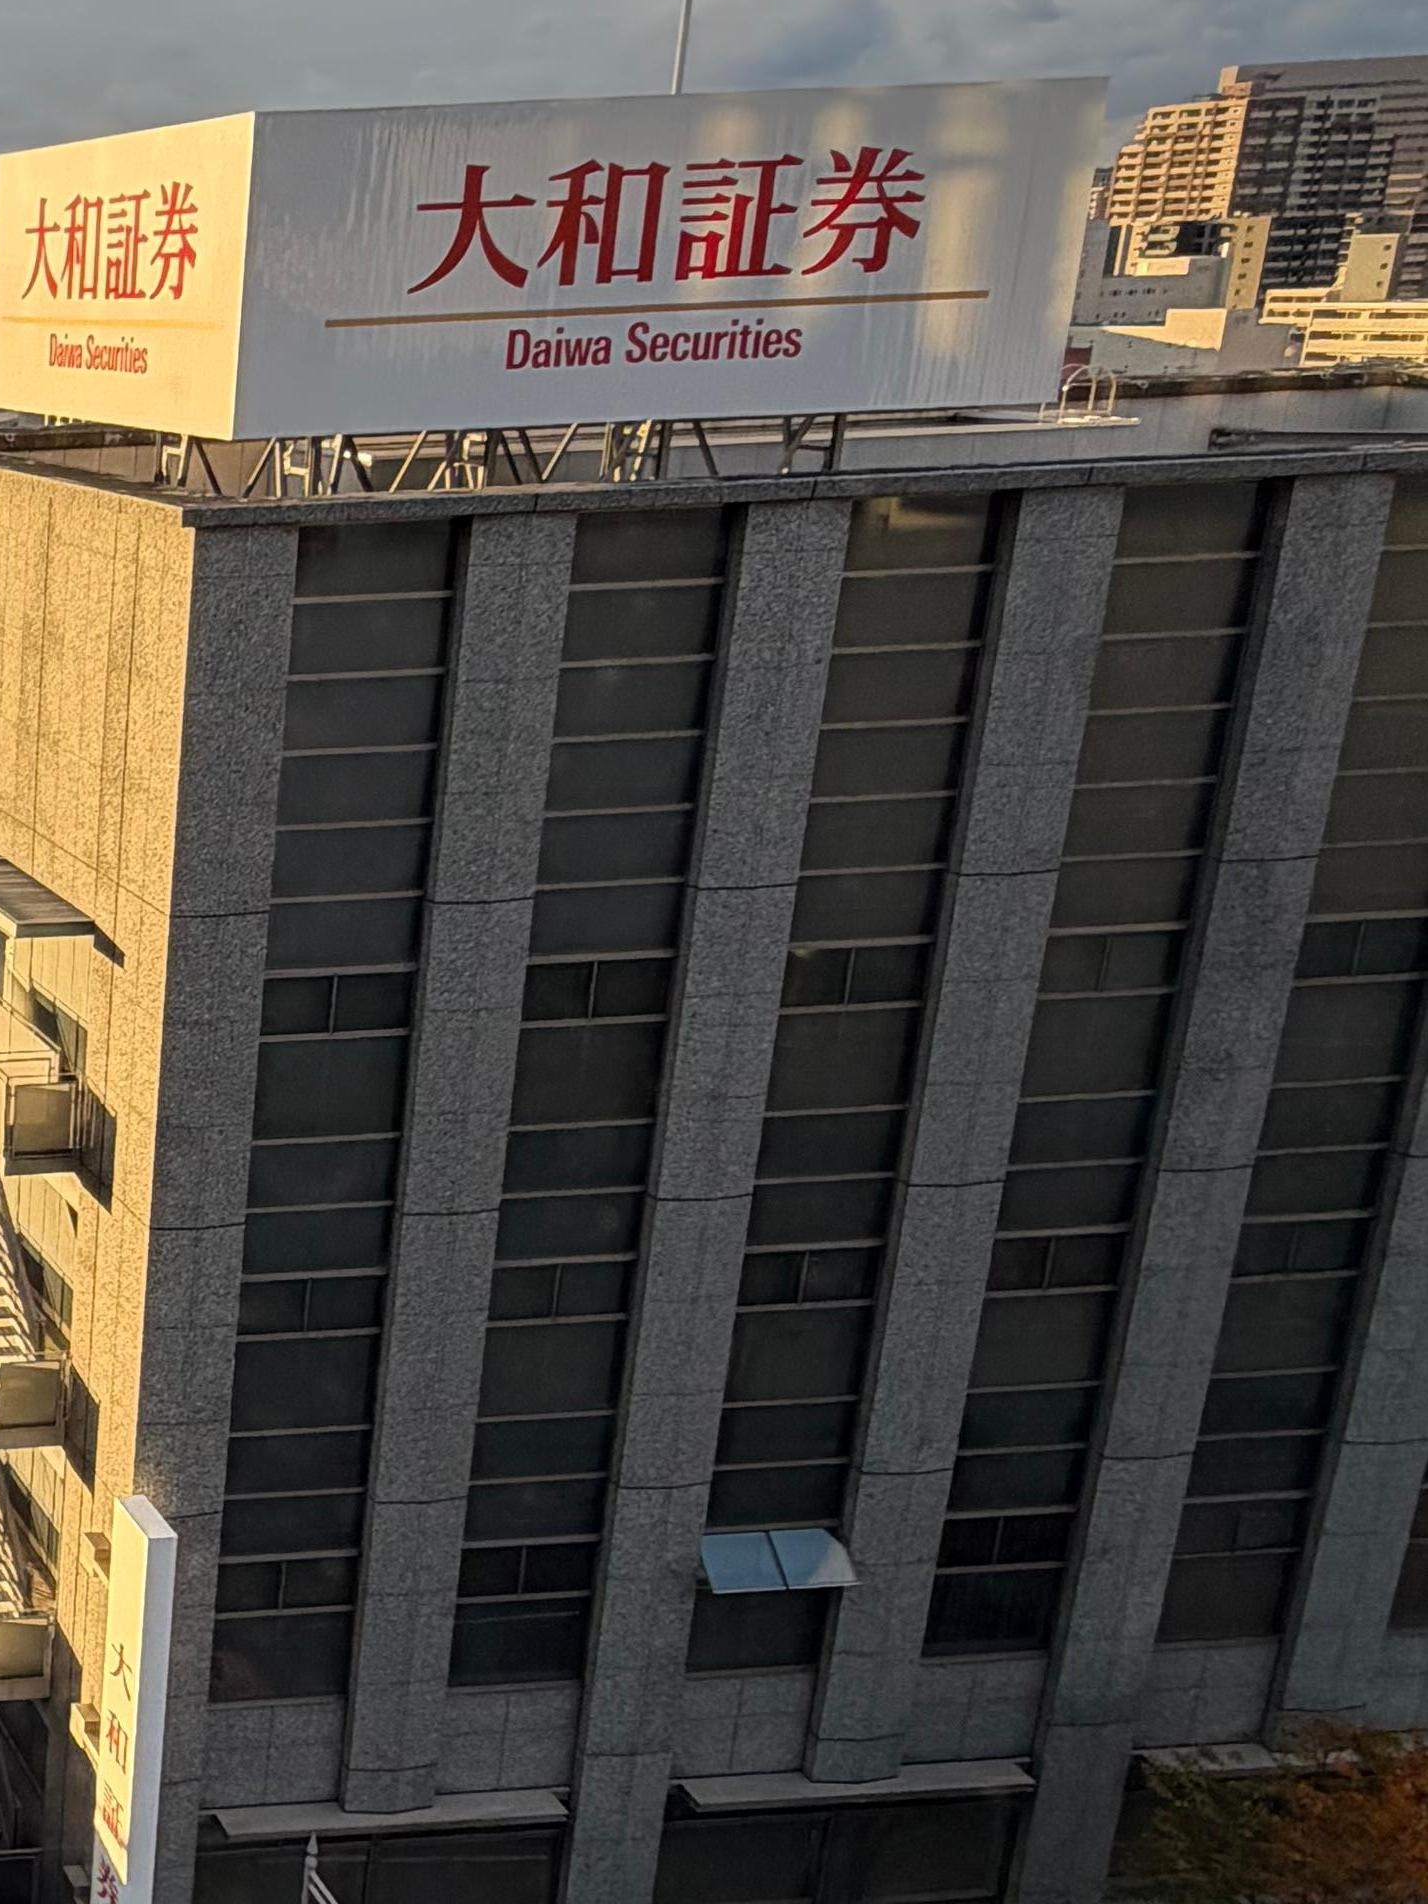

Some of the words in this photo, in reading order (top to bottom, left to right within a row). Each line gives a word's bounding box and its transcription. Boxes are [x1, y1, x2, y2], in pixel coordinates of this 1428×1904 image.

[22, 181, 199, 300] 大和証券
[407, 146, 926, 295] 大和証券
[49, 333, 83, 370] Daiwa
[85, 334, 148, 374] Securities
[505, 326, 611, 371] Daiwa
[625, 318, 803, 364] Securities
